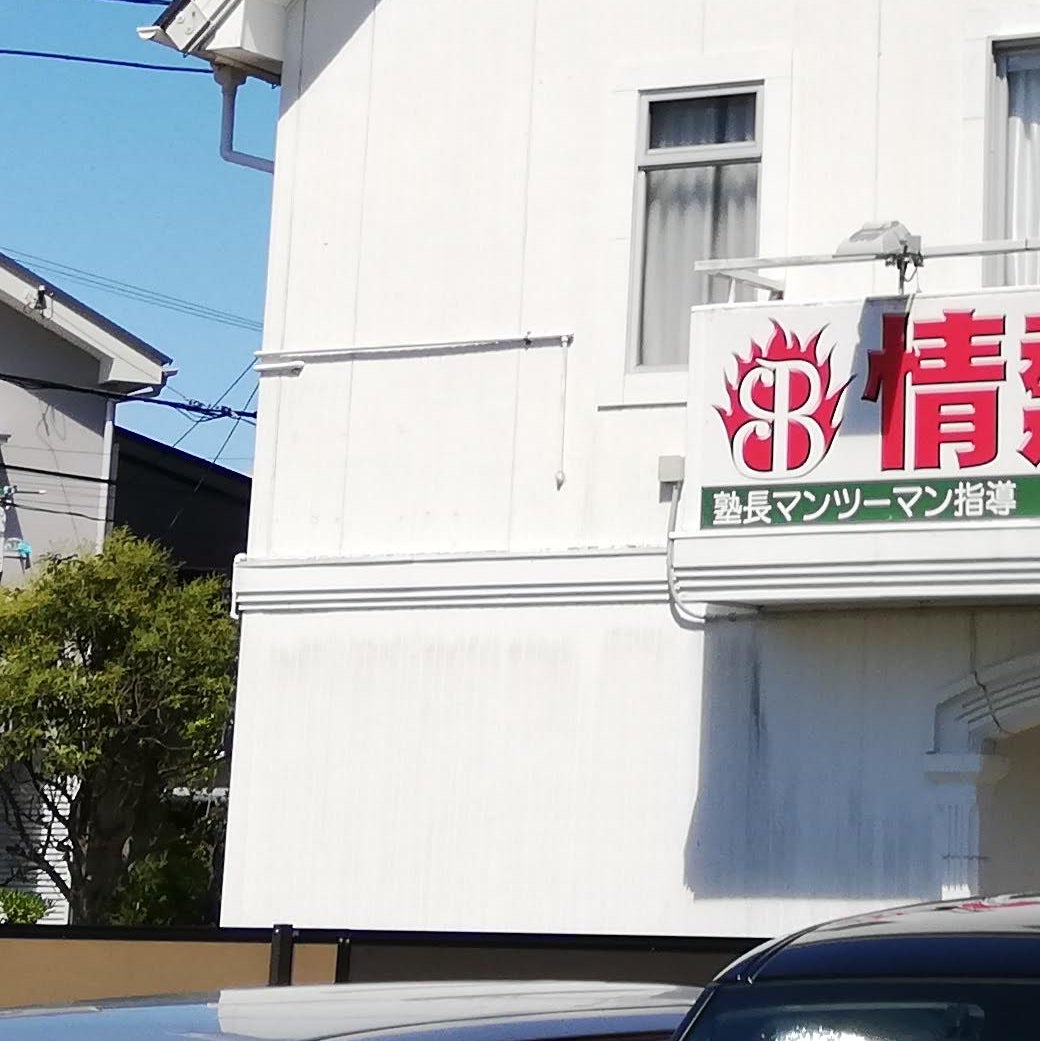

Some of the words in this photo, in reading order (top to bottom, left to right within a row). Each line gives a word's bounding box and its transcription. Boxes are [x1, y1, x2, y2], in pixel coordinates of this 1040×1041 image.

[712, 479, 1017, 527] 塾長マンツーマン指導
